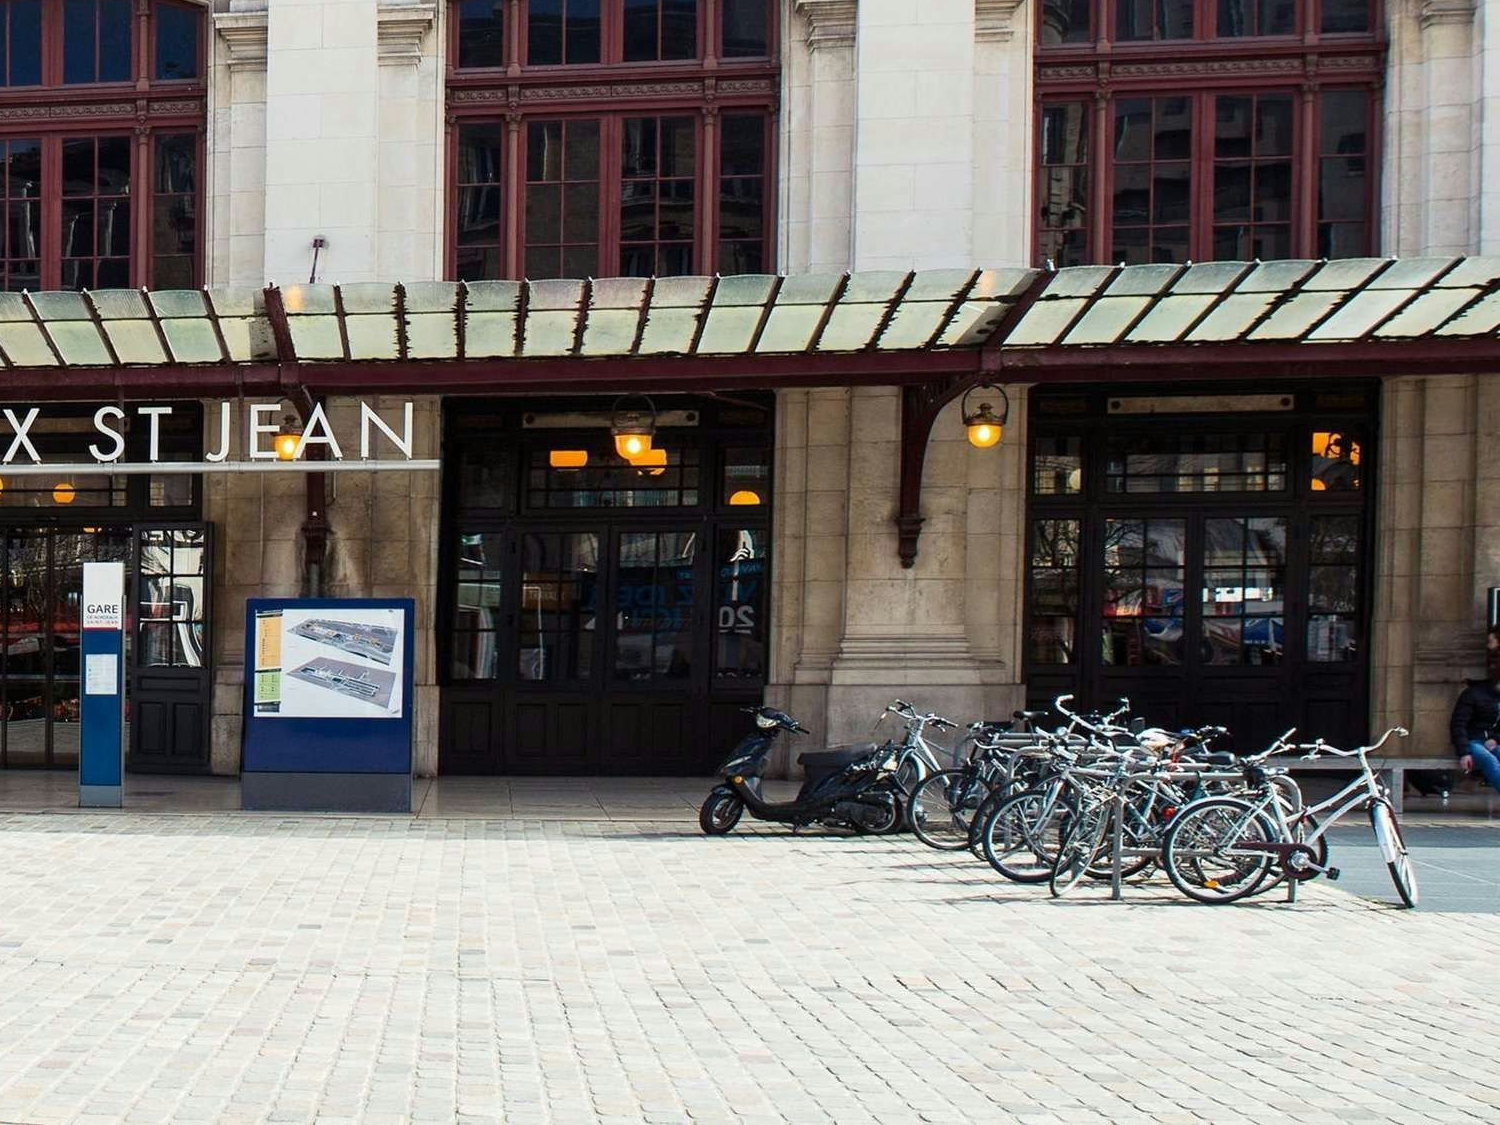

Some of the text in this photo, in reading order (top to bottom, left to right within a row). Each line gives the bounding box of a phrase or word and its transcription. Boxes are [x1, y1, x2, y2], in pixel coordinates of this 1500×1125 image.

[88, 406, 172, 463] ST
[205, 401, 413, 461] JEAN
[87, 604, 118, 614] GARE
